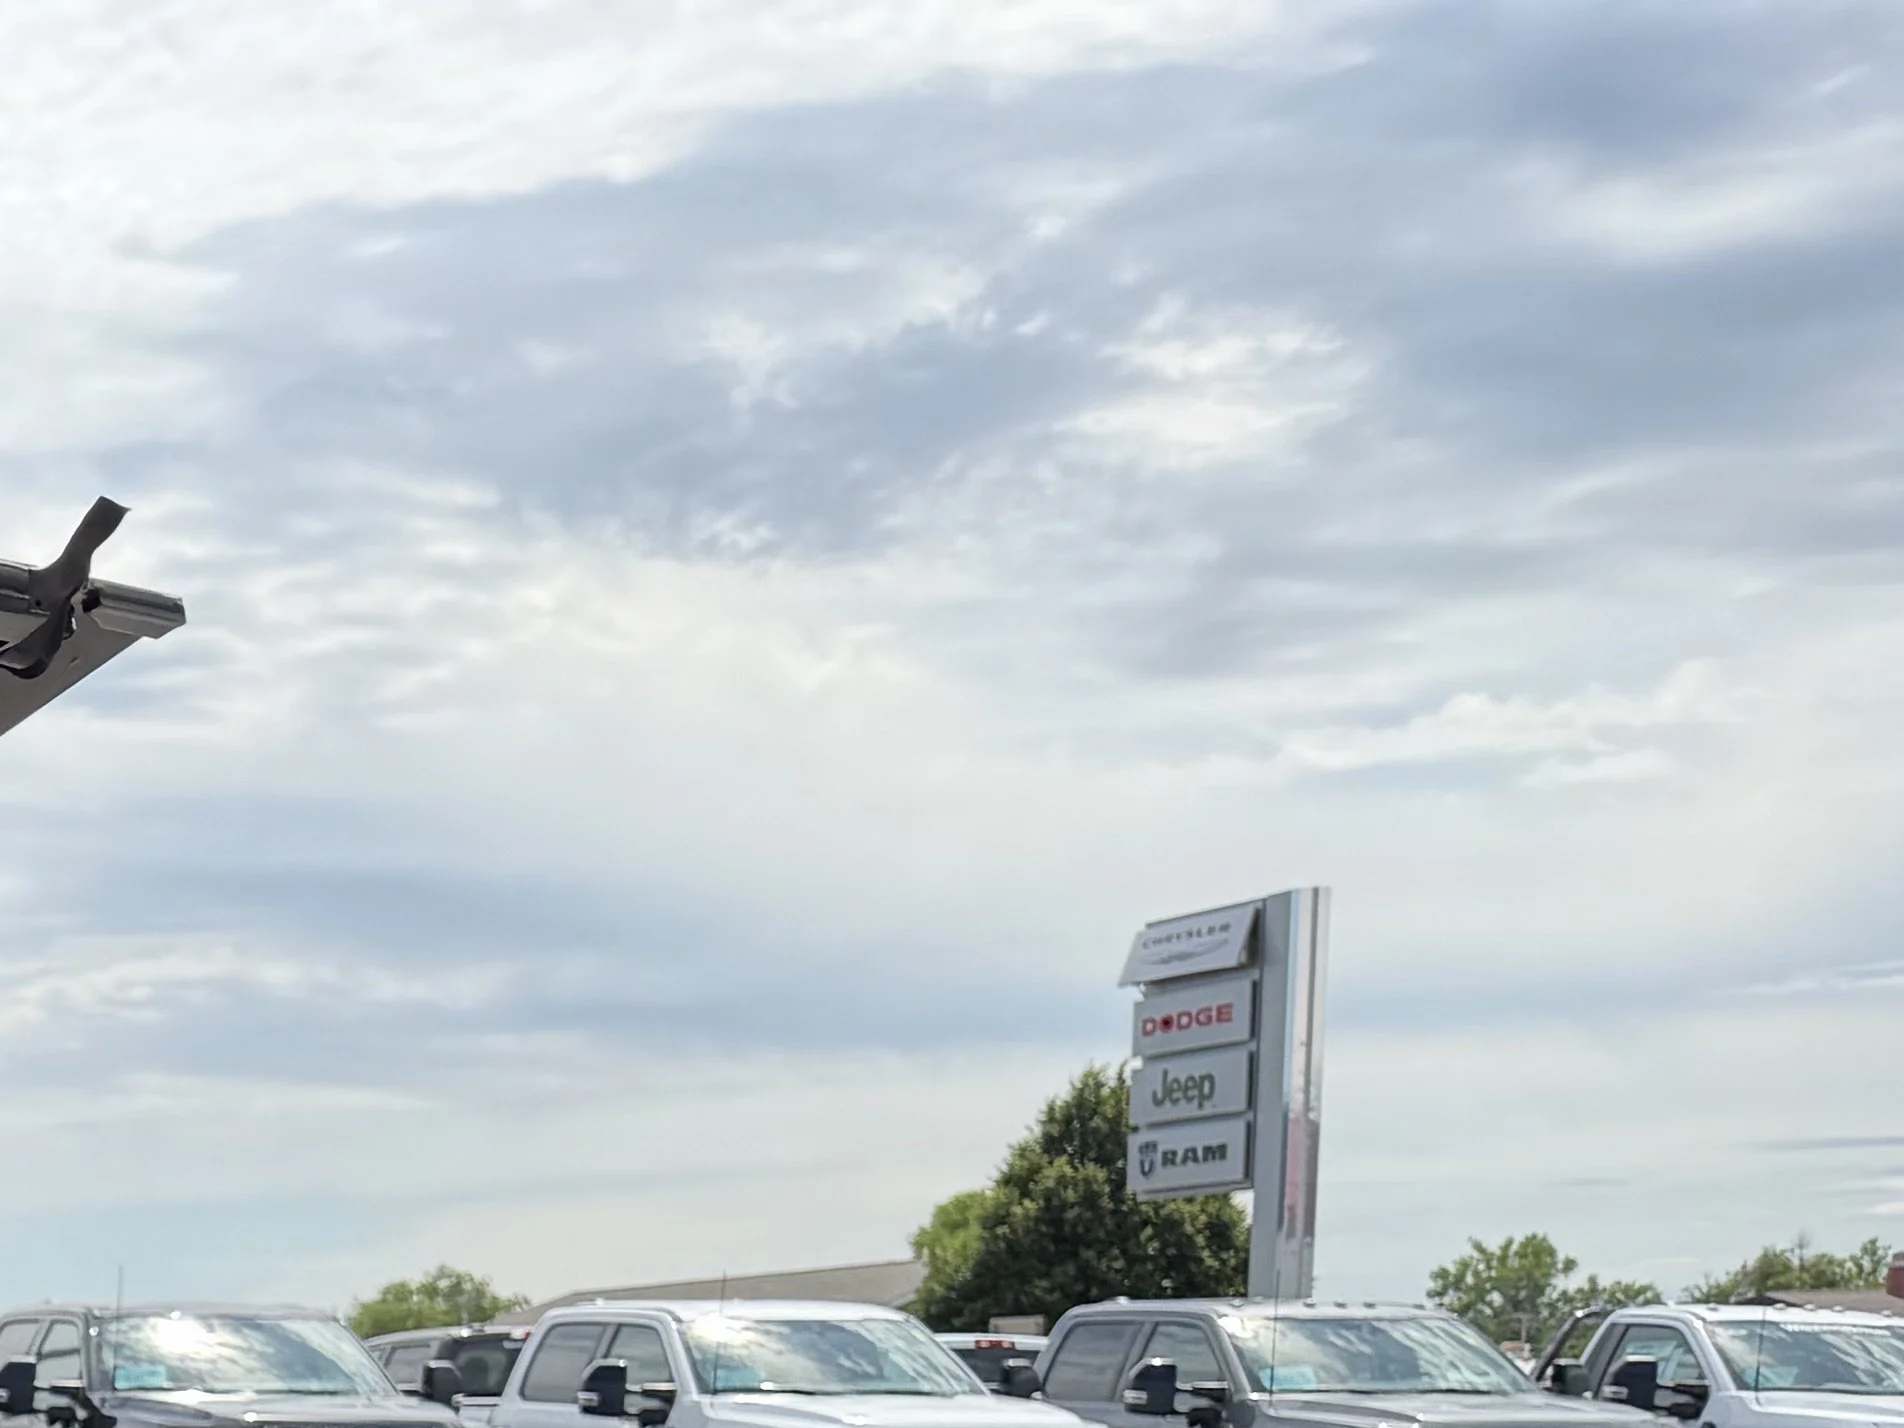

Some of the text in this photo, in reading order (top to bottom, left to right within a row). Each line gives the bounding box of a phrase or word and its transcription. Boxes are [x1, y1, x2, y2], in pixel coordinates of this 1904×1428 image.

[1141, 1002, 1234, 1037] DODGE
[1152, 1068, 1216, 1110] Jeep
[1161, 1143, 1228, 1169] RAM
